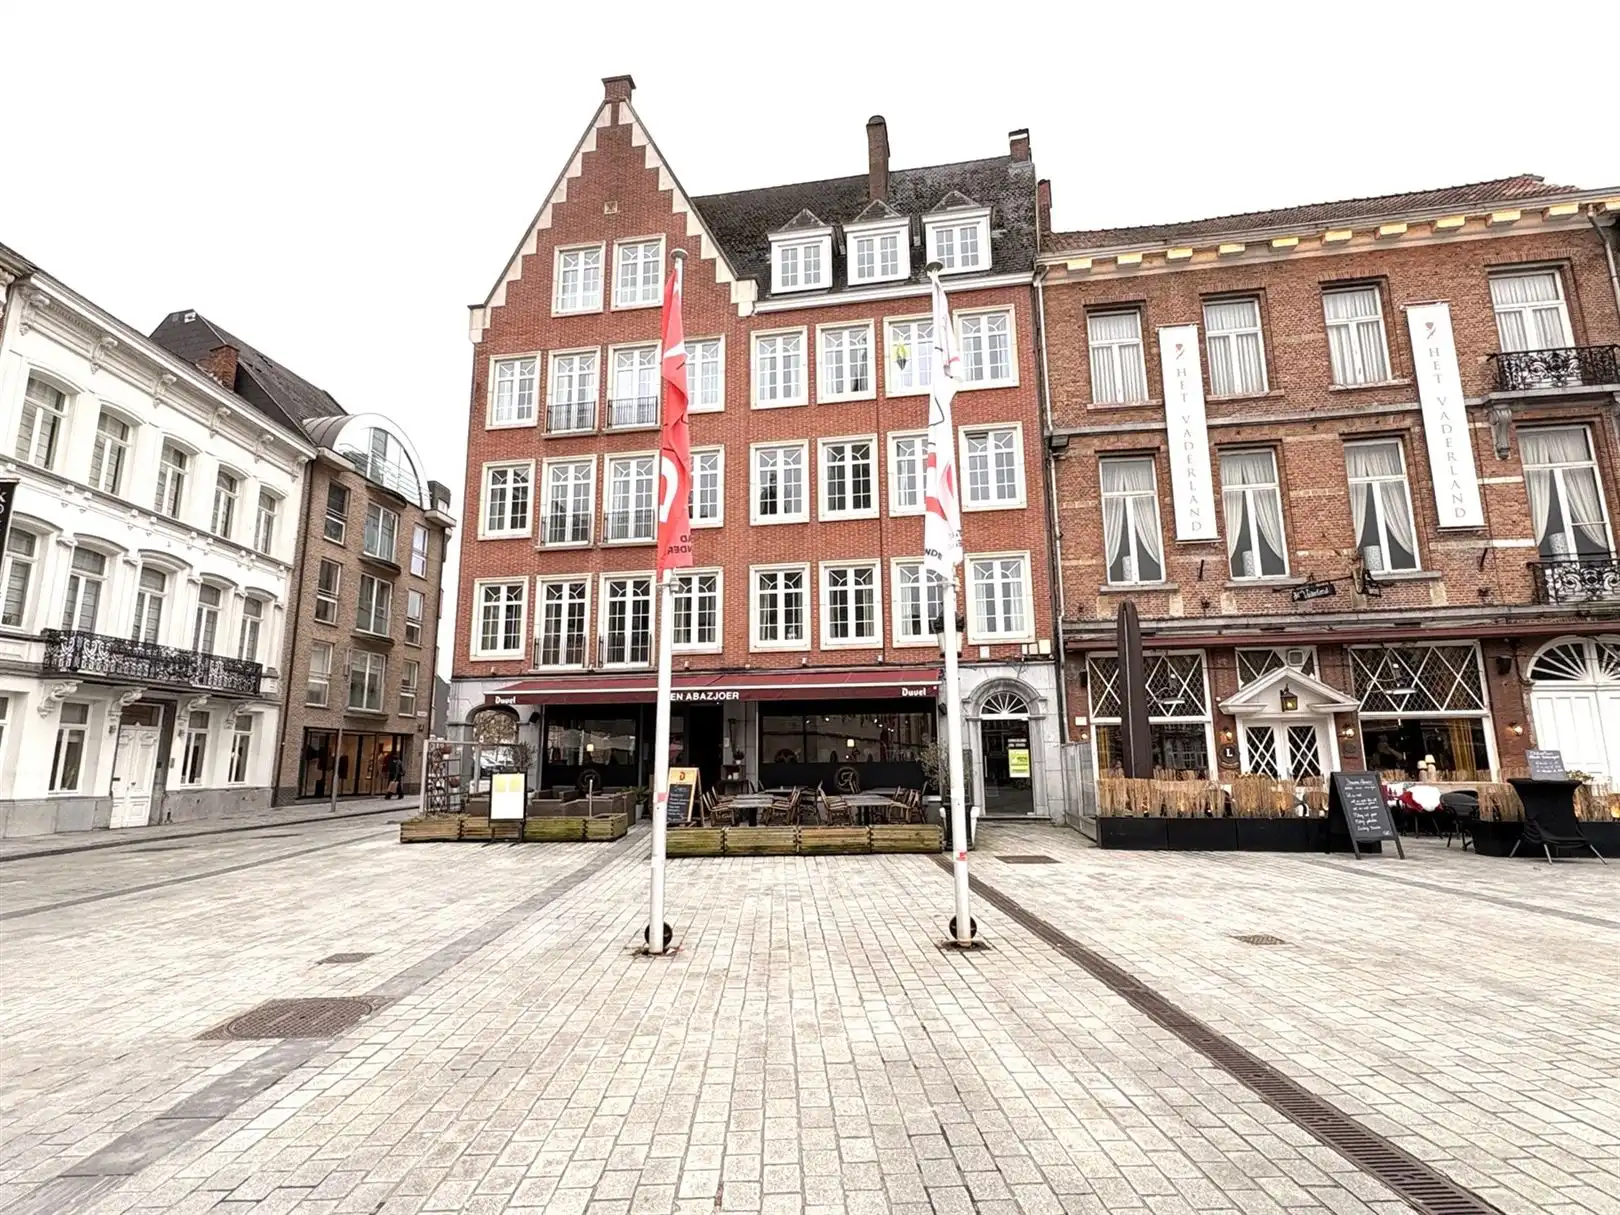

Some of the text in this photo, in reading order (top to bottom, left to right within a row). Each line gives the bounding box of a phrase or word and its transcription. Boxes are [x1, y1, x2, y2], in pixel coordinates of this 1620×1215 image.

[1429, 347, 1466, 519] HET VADERLAND
[1176, 367, 1202, 532] HET VADERLAND
[902, 687, 925, 696] Duvel
[495, 696, 516, 704] Duvel
[670, 692, 739, 701] EN ABAZJOER
